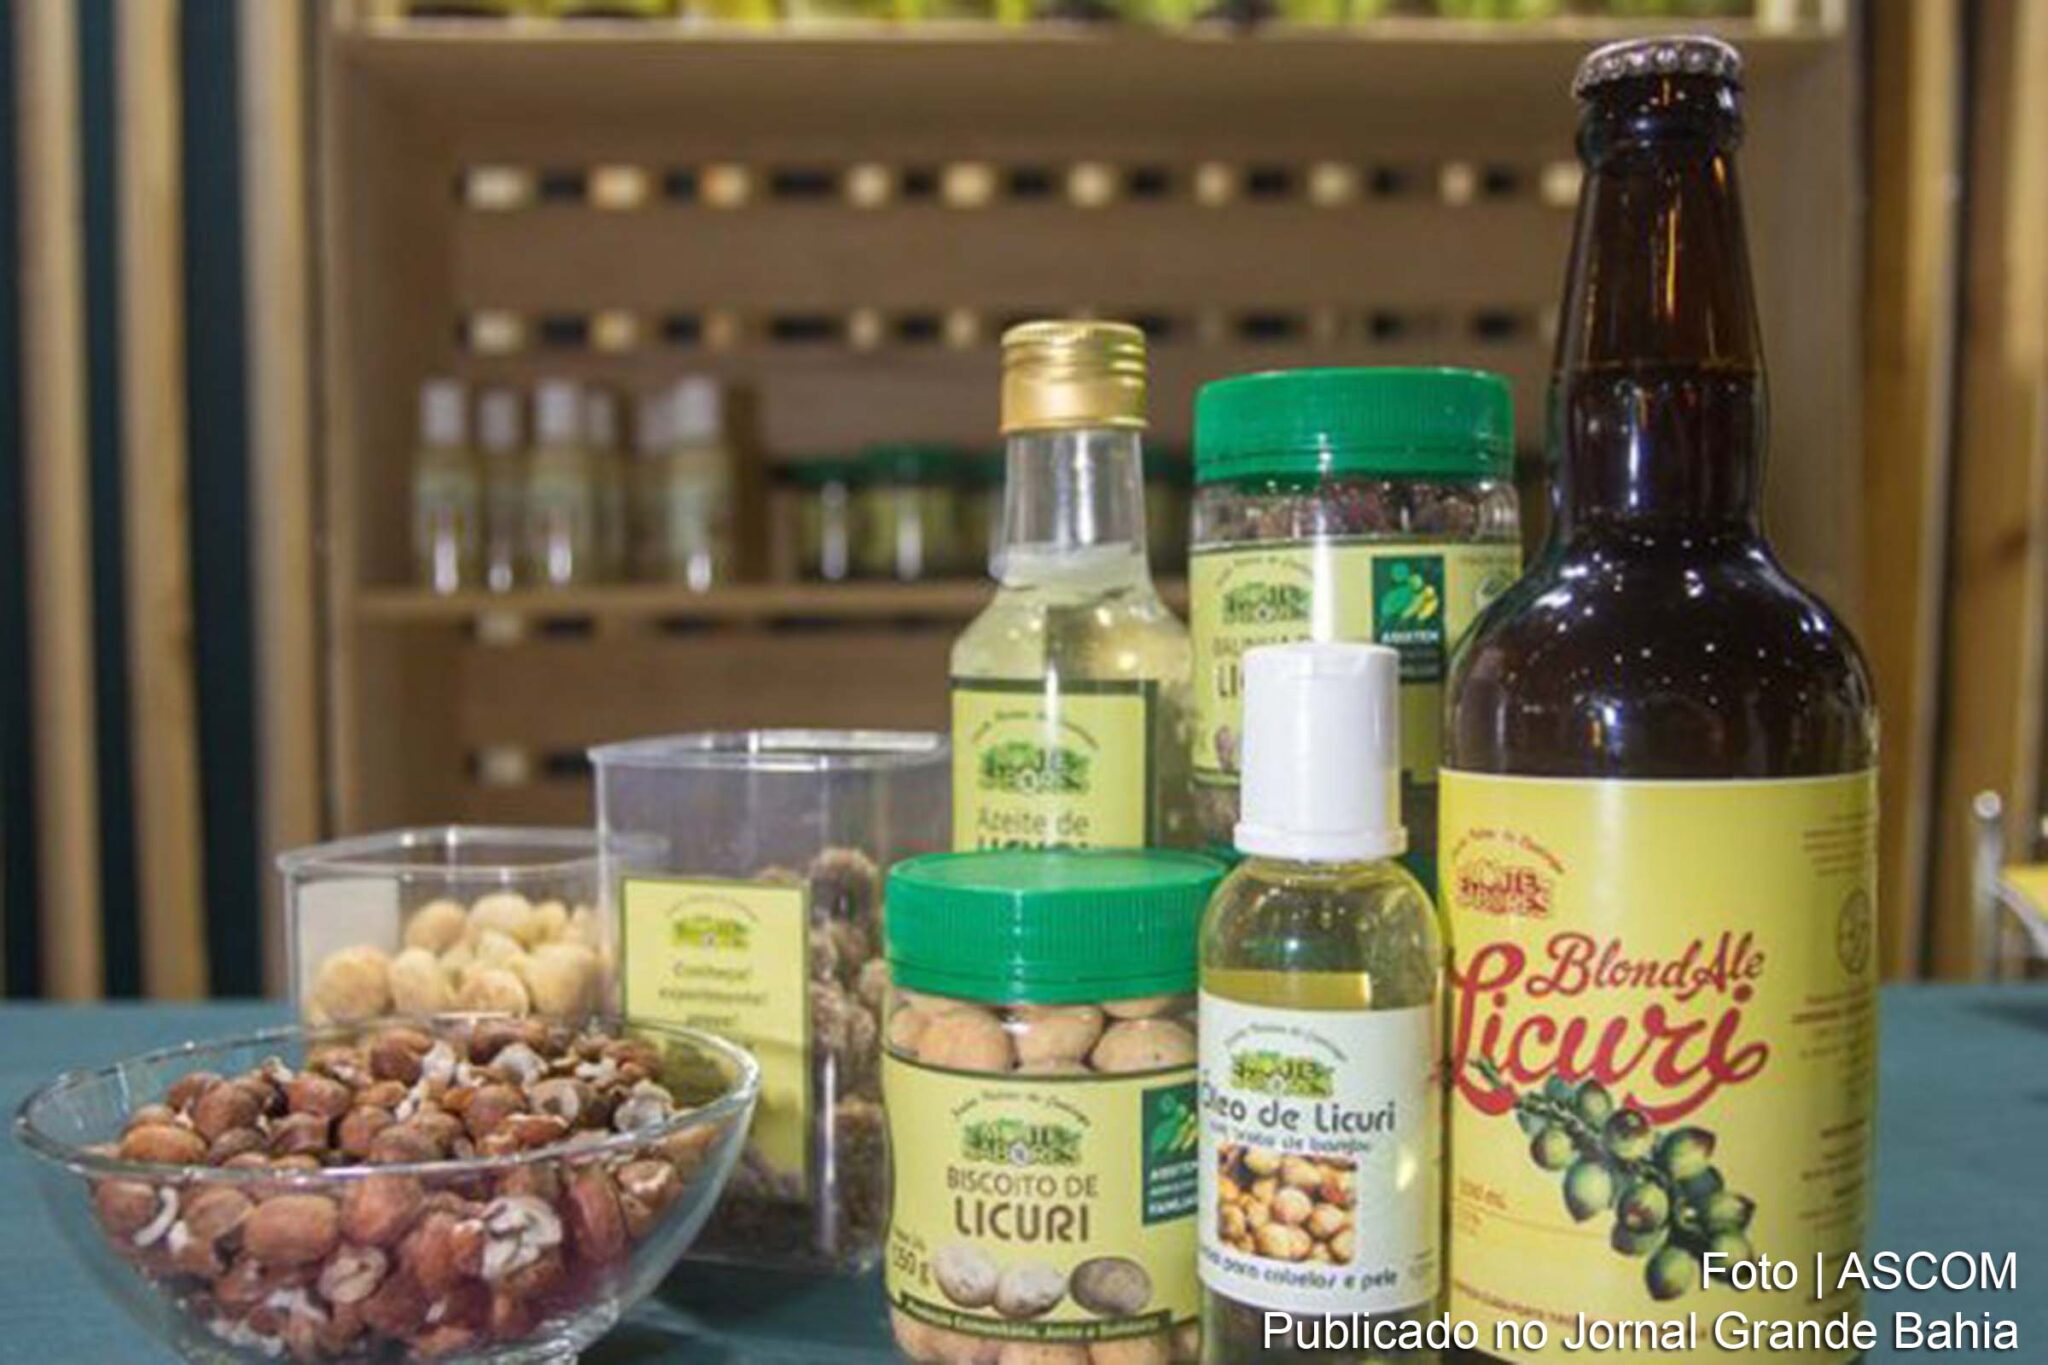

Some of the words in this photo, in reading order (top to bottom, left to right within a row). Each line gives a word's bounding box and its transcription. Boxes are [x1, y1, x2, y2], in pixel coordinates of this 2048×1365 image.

[1450, 942, 1768, 1125] Licuri
[1258, 1102, 1301, 1131] de
[1315, 1102, 1396, 1134] Licuri
[1065, 1174, 1098, 1197] DE
[954, 1197, 1090, 1243] LICURI
